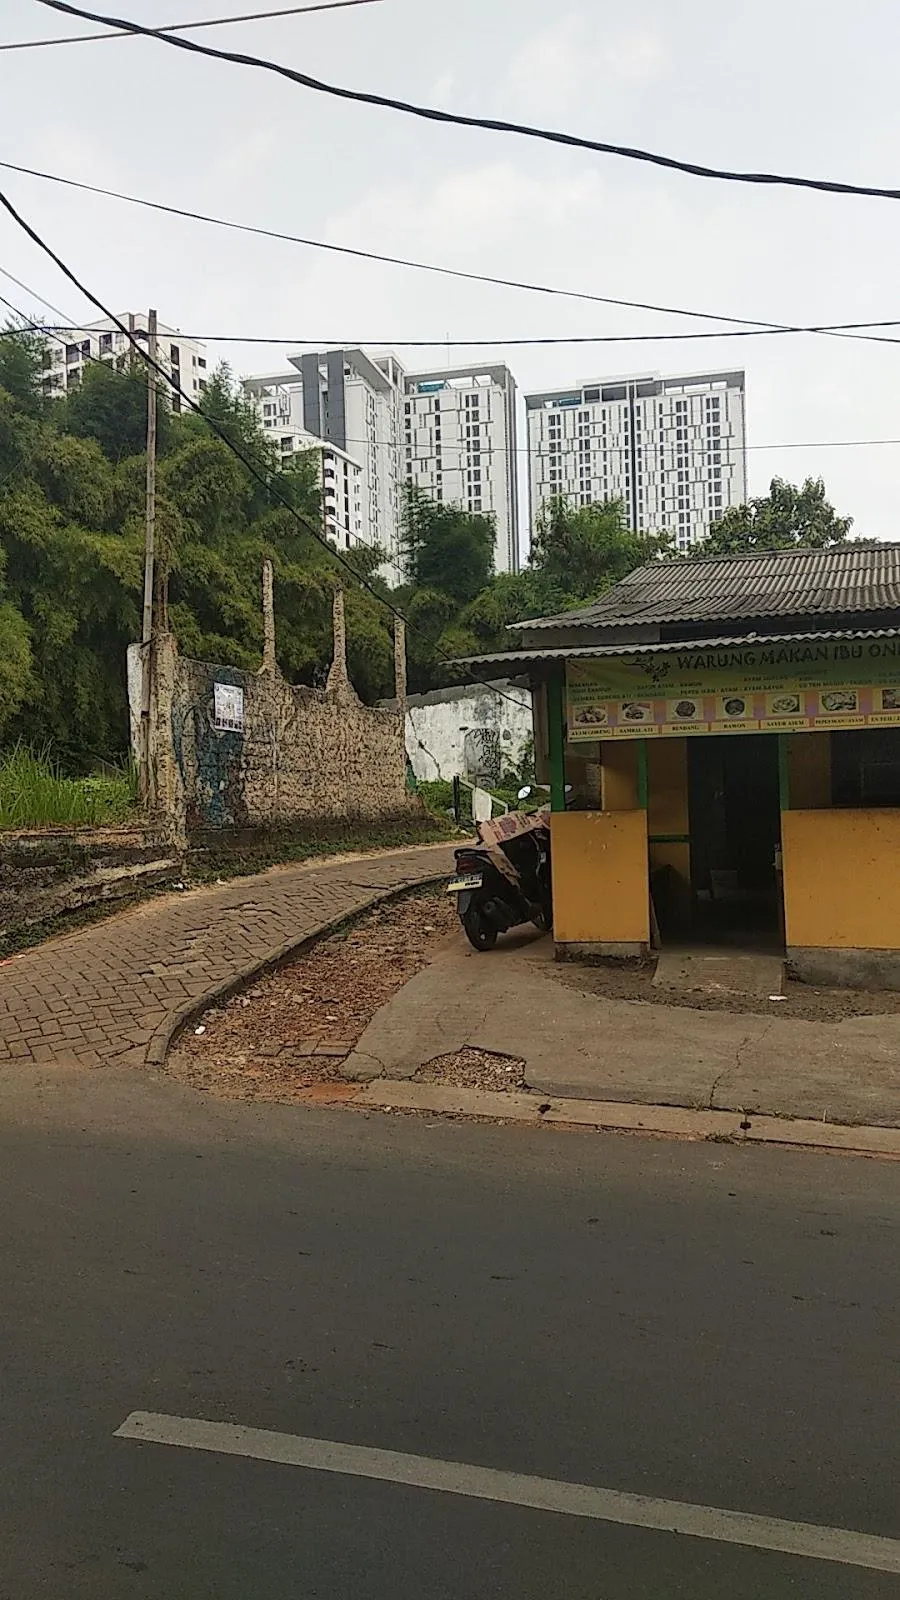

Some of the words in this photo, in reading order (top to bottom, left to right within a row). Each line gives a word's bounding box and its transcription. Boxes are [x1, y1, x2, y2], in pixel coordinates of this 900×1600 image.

[677, 651, 755, 669] WARUNG
[759, 646, 828, 666] MAKAN
[833, 645, 863, 660] IBU
[869, 642, 900, 658] ON
